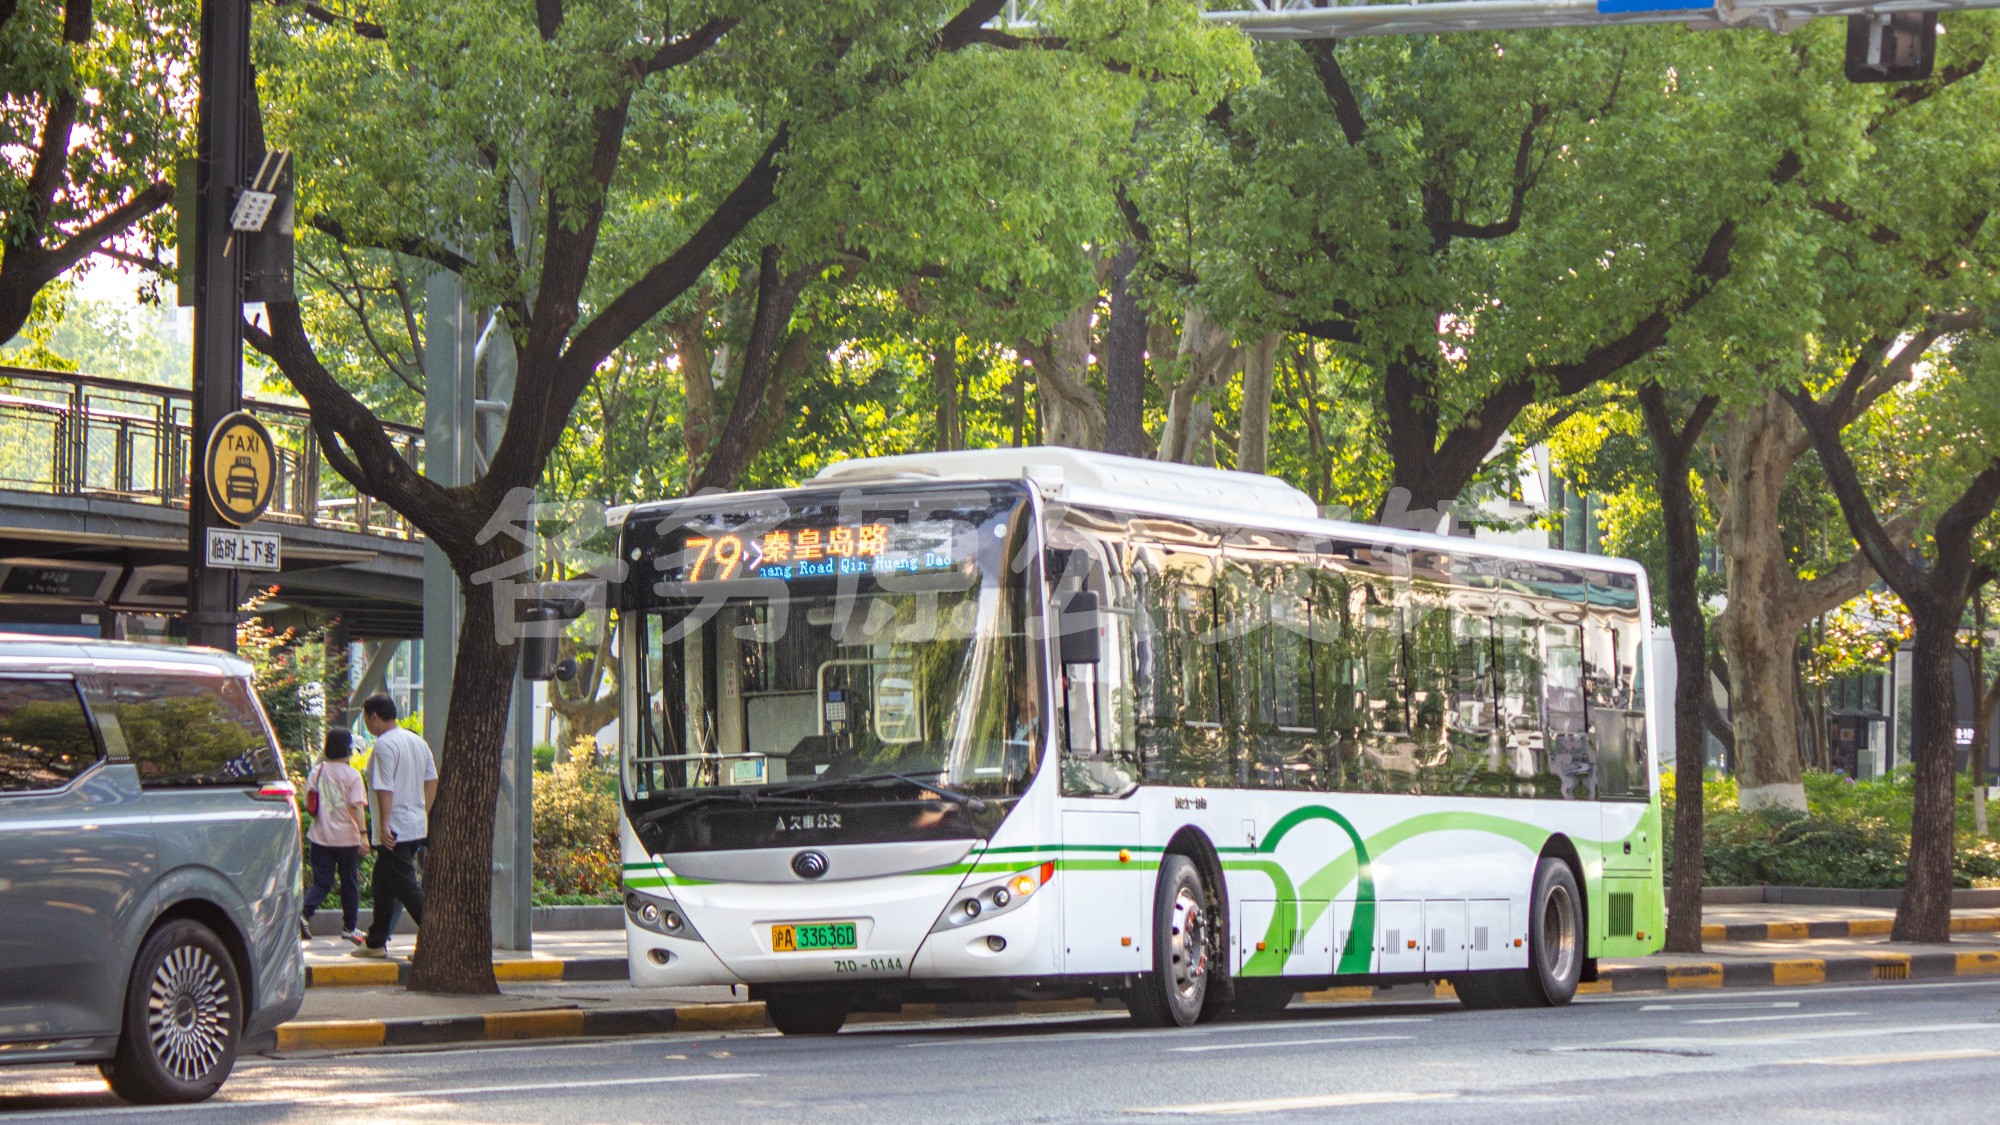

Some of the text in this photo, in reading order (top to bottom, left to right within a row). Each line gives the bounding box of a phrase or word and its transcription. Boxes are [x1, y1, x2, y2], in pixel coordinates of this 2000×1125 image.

[227, 435, 259, 454] TAXI
[212, 537, 276, 564] 临时上下客
[763, 524, 887, 562] 秦皇岛路
[686, 535, 742, 582] 79
[800, 558, 834, 576] Road
[840, 556, 867, 574] Qin
[873, 552, 920, 571] Huang
[925, 552, 952, 567] Dao
